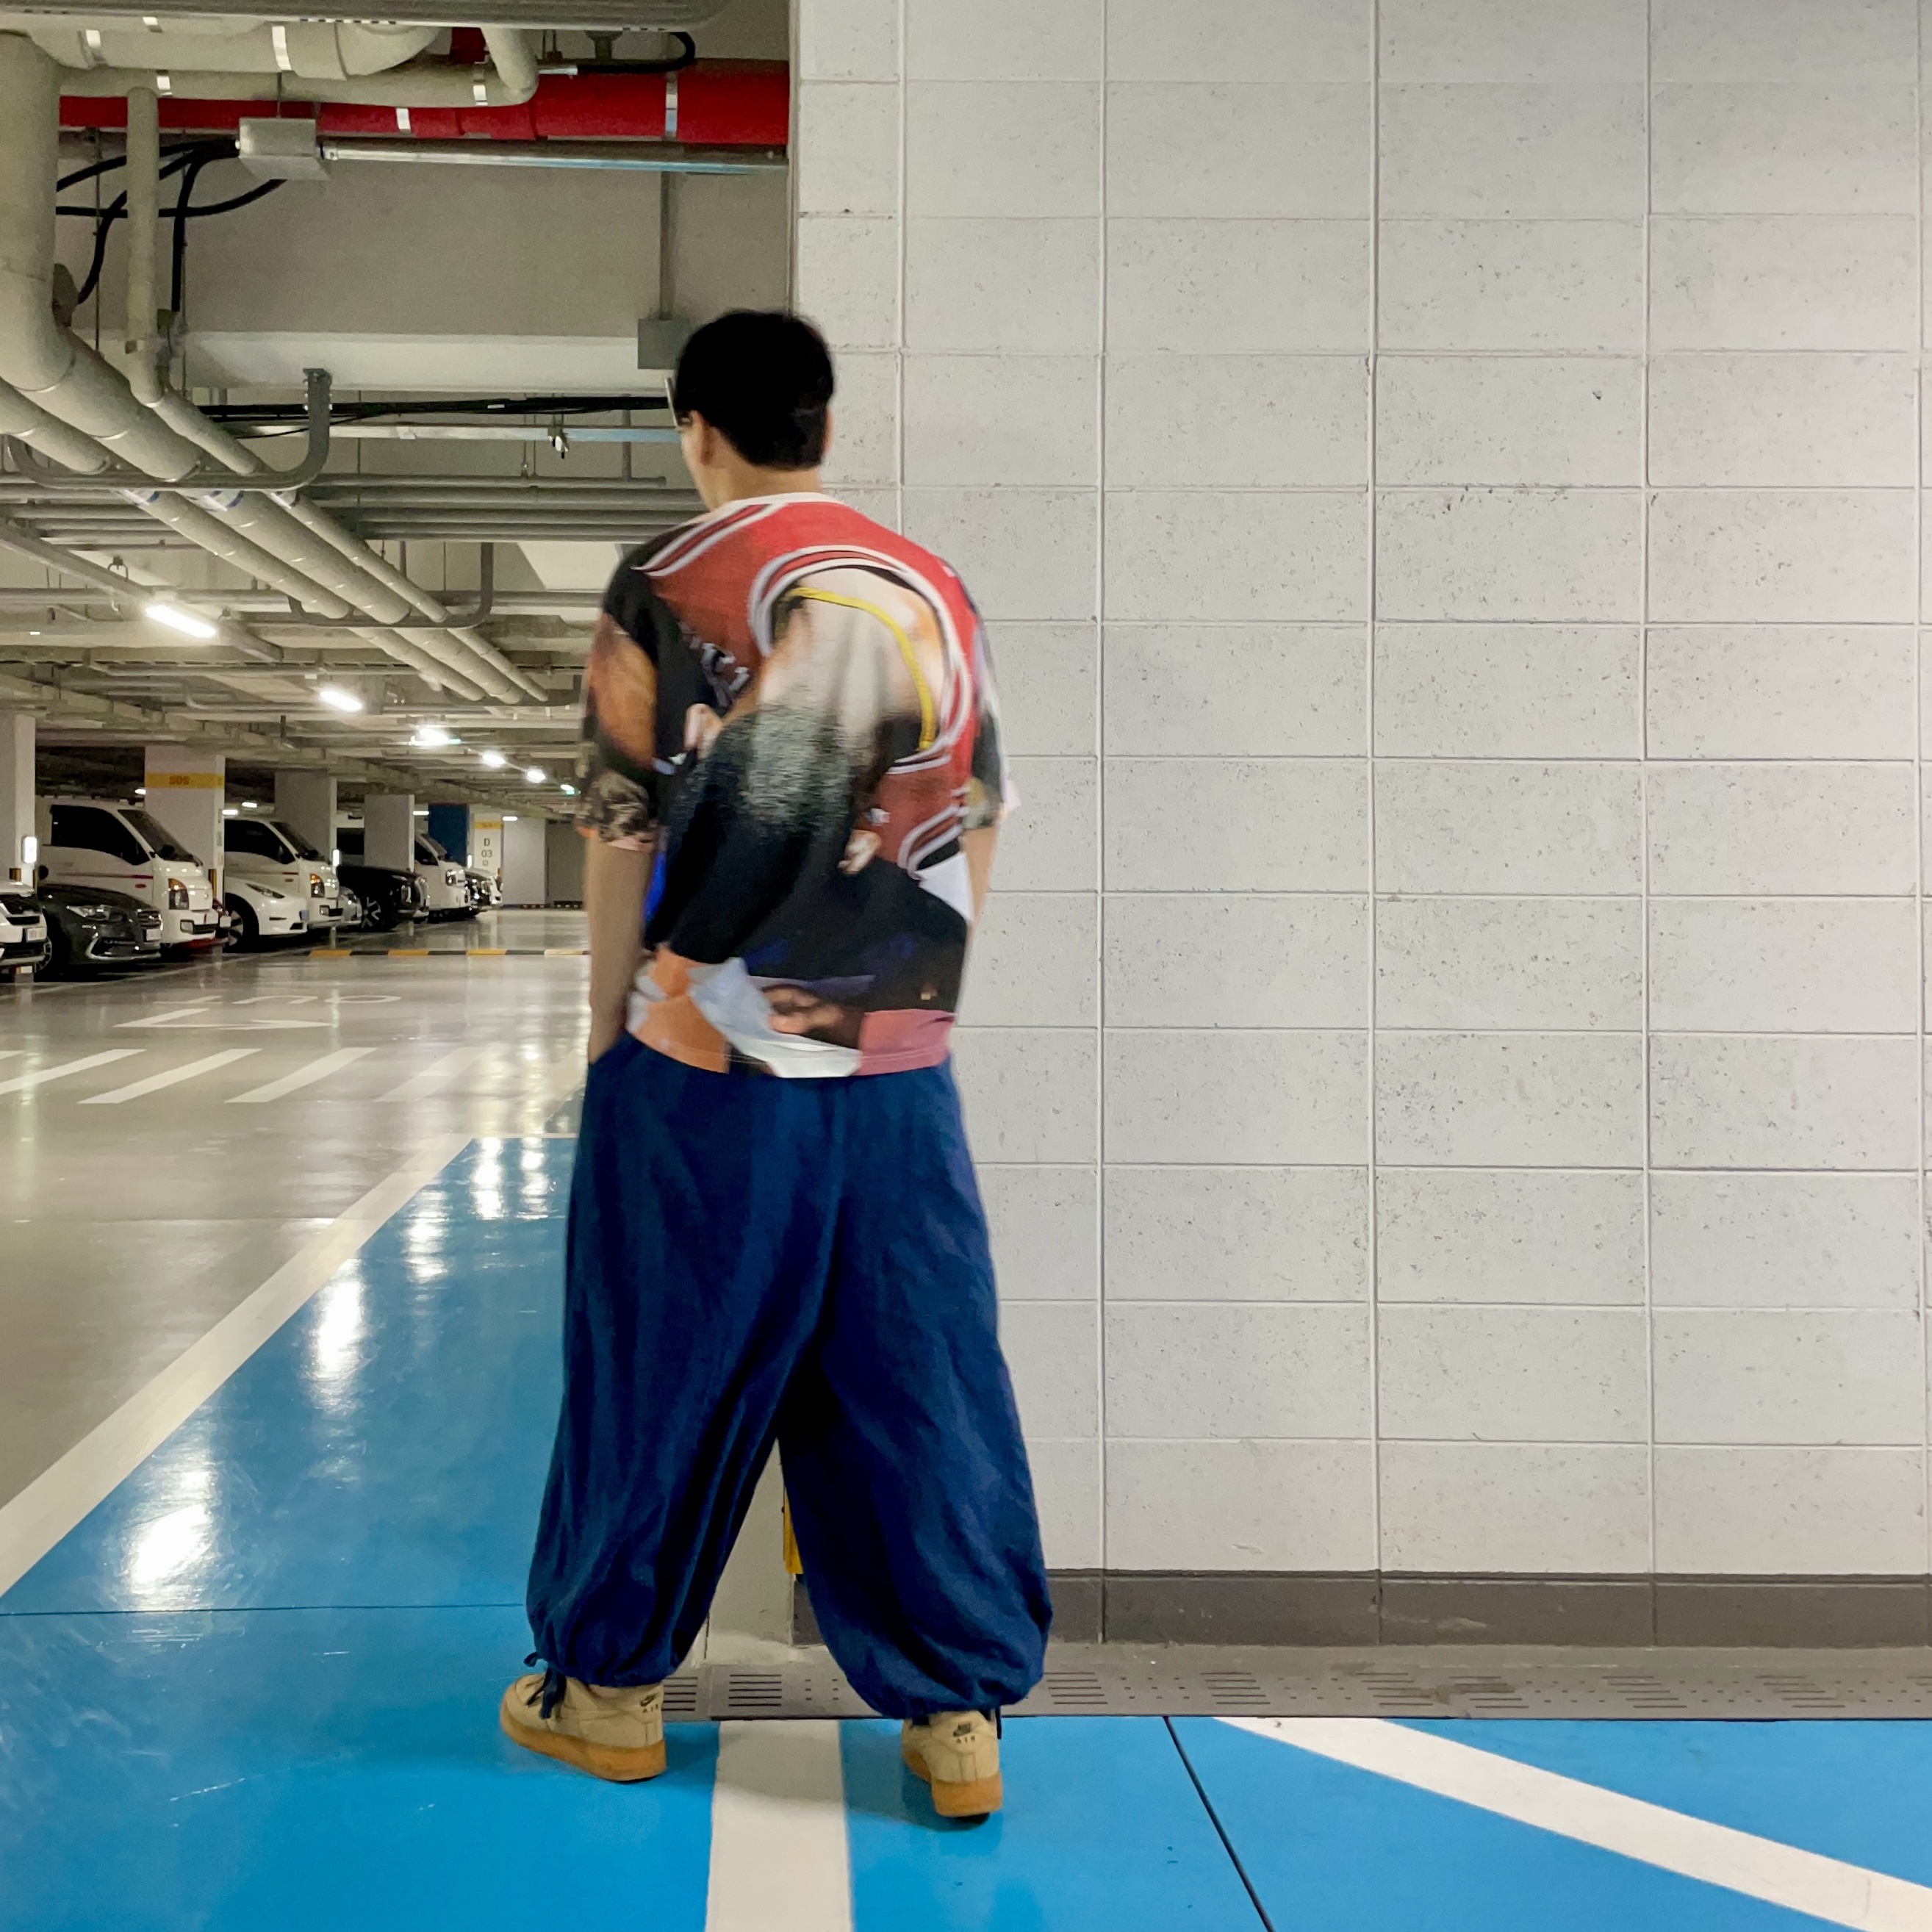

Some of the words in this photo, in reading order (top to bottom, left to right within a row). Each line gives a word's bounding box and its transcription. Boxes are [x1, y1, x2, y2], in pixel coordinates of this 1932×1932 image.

[169, 776, 190, 786] SOS
[484, 838, 490, 847] D
[481, 849, 492, 858] 03
